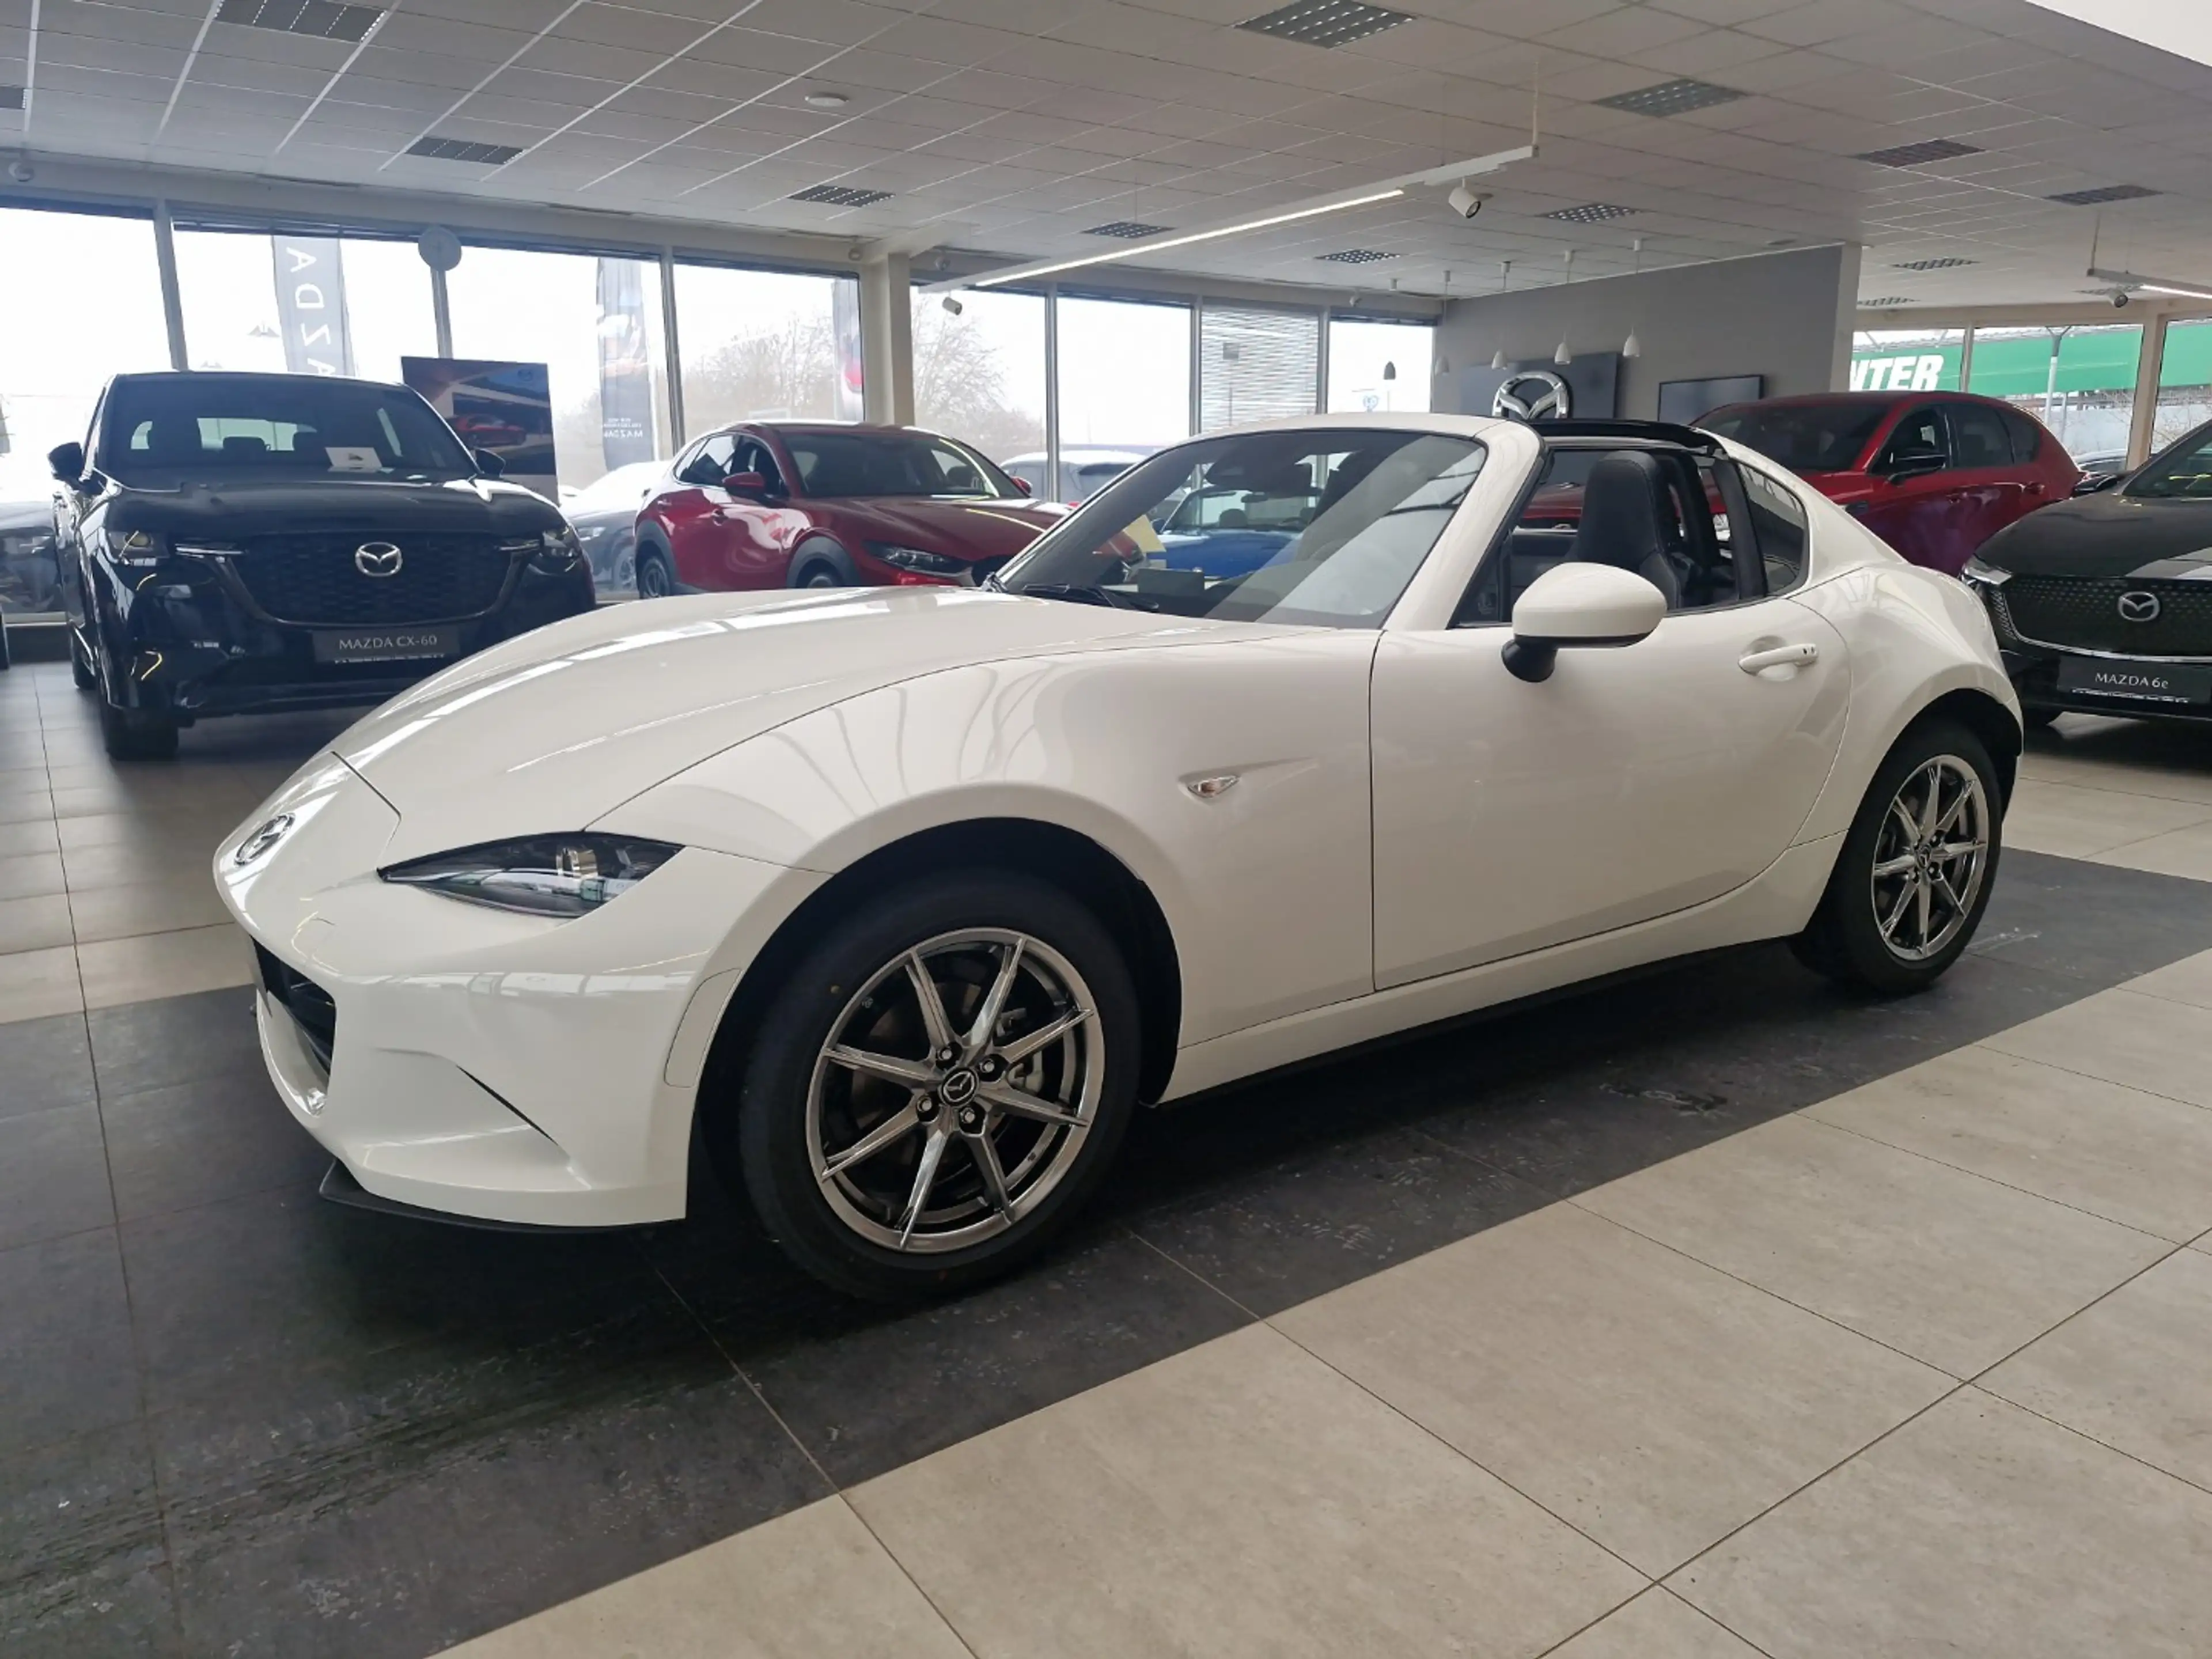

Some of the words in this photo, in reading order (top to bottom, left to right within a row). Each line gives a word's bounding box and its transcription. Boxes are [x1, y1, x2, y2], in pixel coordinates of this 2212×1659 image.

[339, 637, 393, 650] MAZDA
[396, 635, 437, 647] CX-60
[2094, 672, 2149, 687] MAZDA
[2152, 677, 2169, 689] 6e
